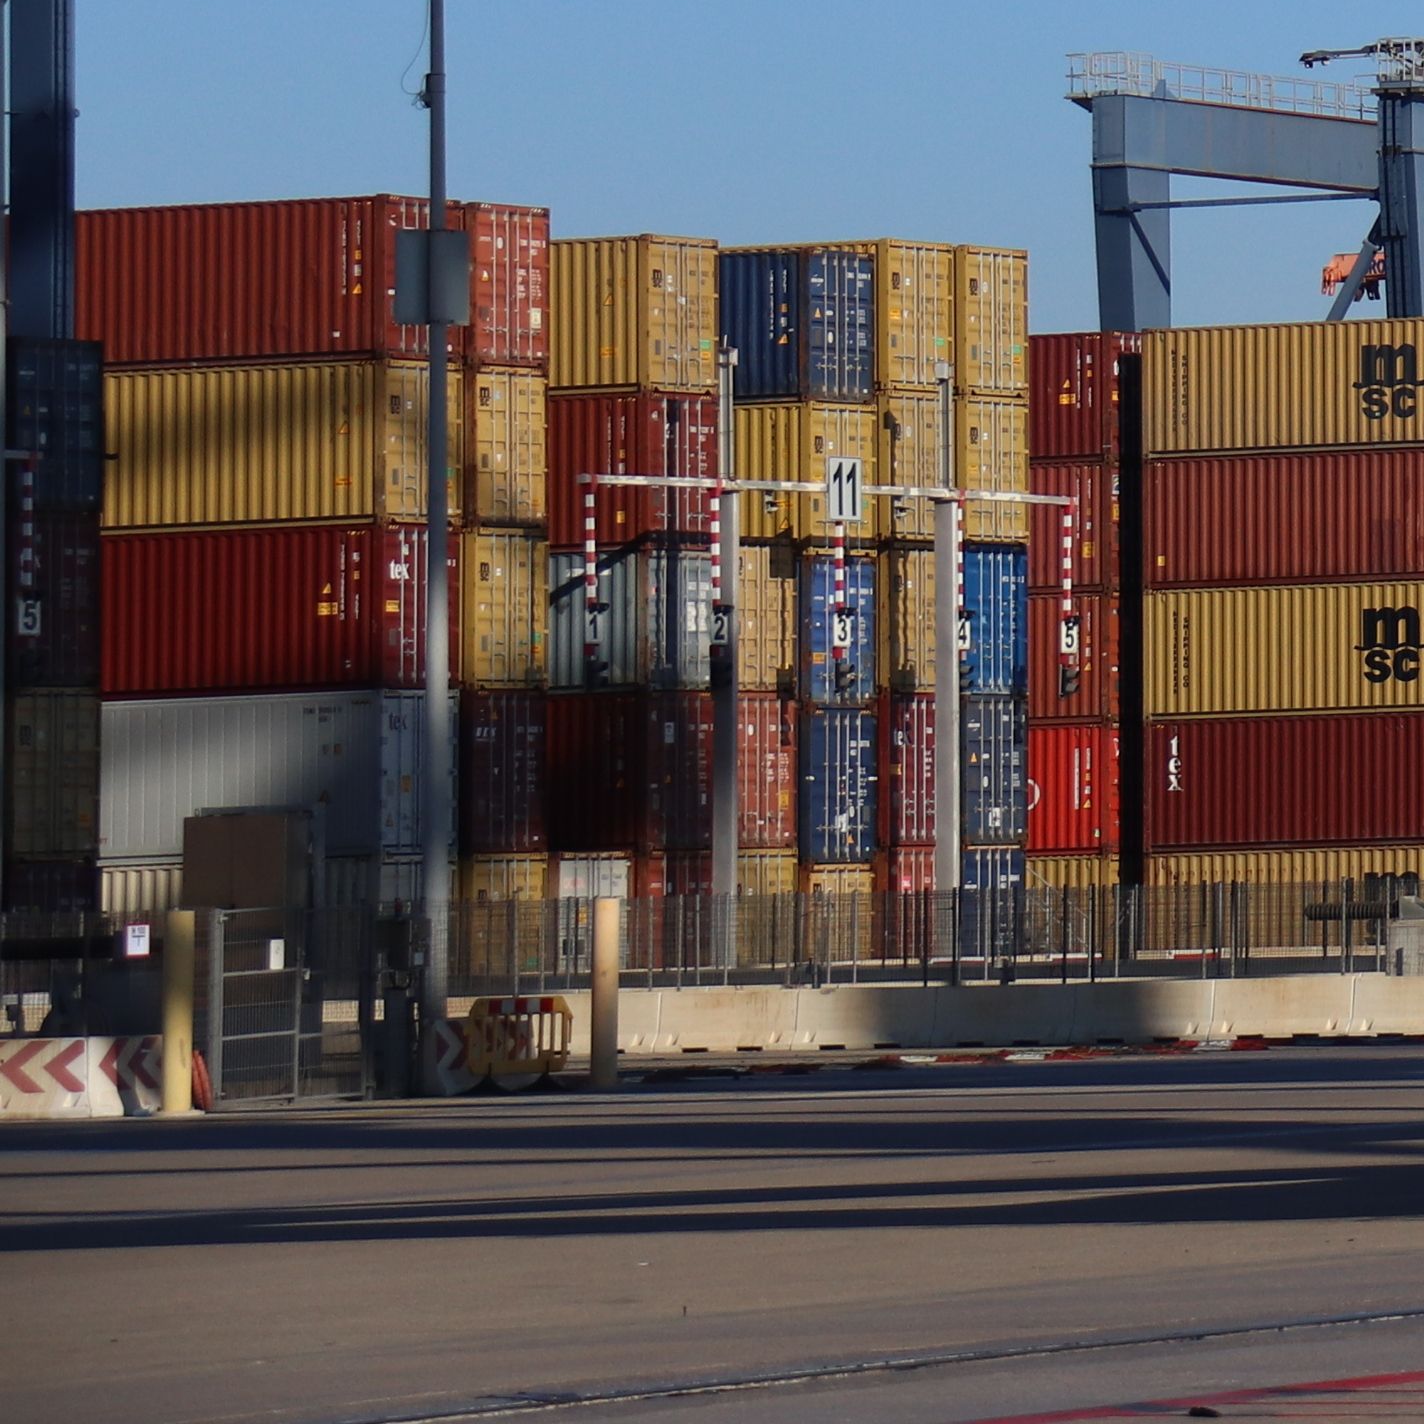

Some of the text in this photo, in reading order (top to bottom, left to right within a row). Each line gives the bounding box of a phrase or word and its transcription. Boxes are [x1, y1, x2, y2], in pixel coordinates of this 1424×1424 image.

[833, 462, 857, 516] 11
[389, 559, 410, 580] tex
[23, 601, 36, 630] 5
[589, 614, 598, 640] 1
[714, 615, 726, 641] 2
[837, 618, 848, 642] 3
[1065, 624, 1075, 649] 5
[389, 711, 407, 730] tex
[1168, 735, 1184, 791] tex
